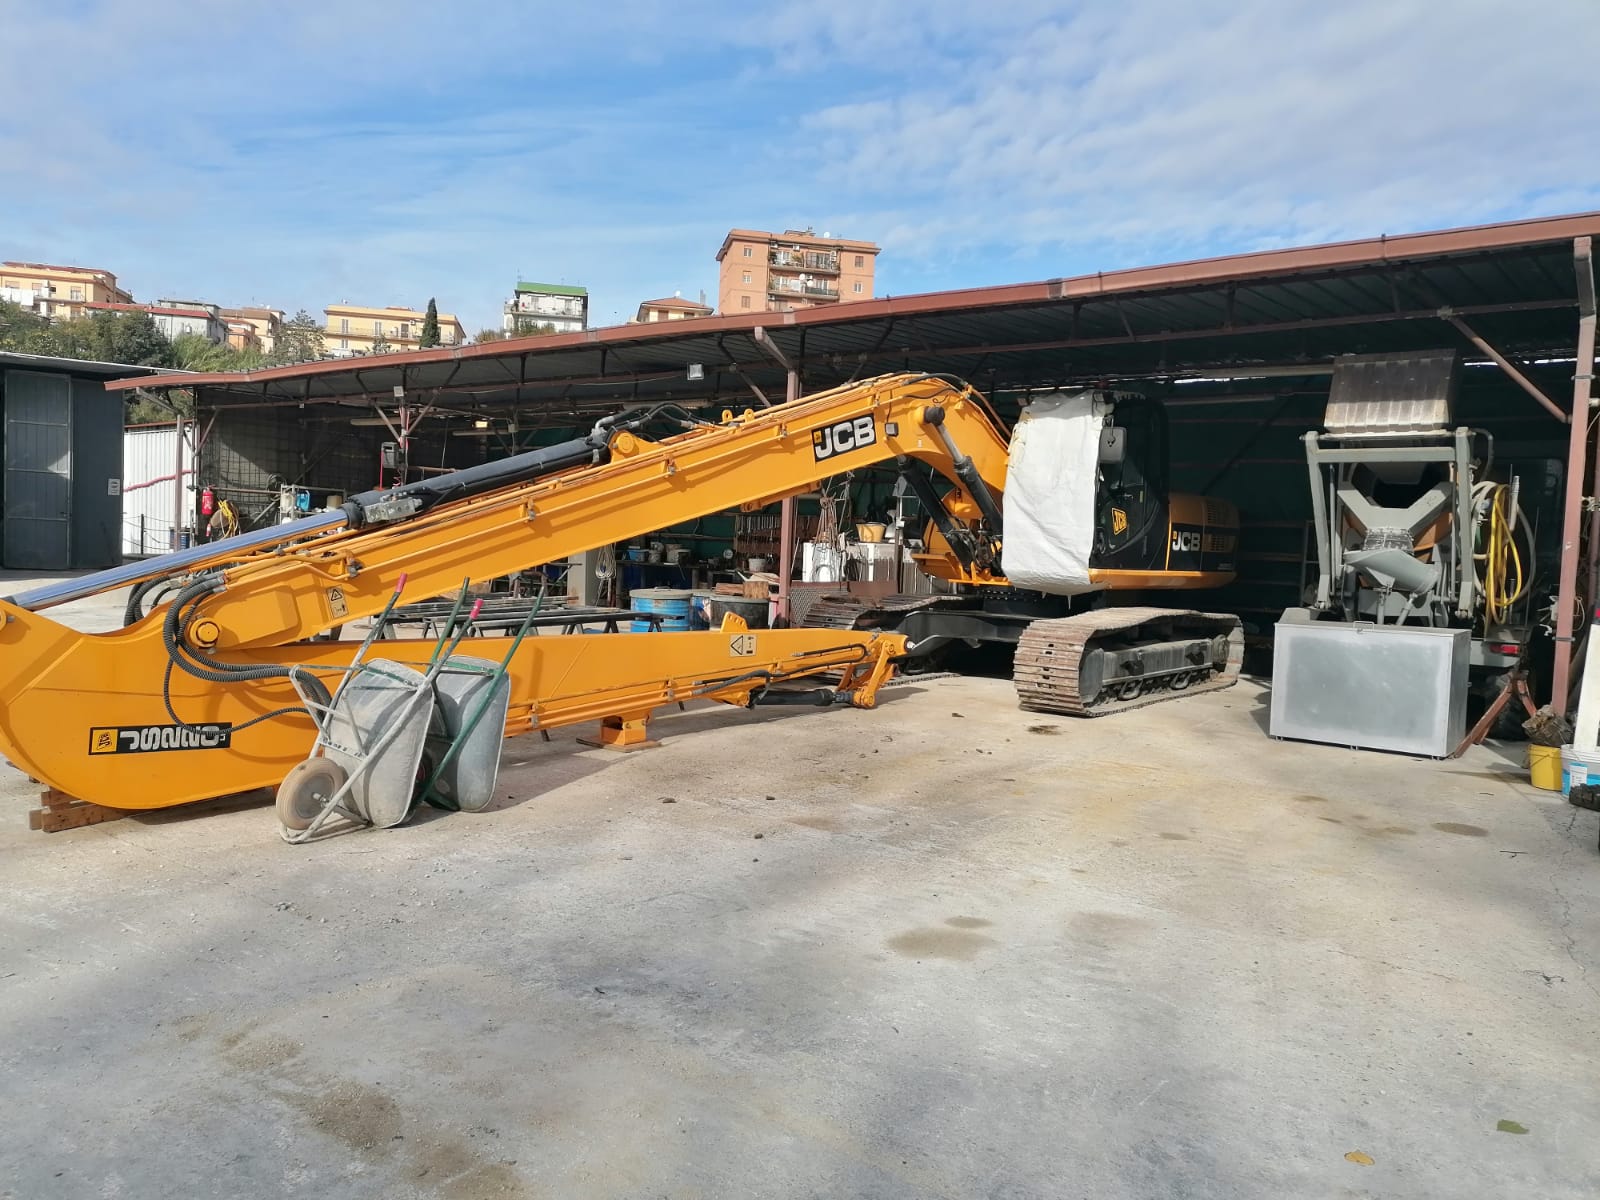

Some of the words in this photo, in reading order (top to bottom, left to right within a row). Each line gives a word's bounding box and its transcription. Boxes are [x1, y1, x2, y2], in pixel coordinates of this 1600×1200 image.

[815, 416, 875, 459] JCB
[1114, 510, 1127, 532] JCB
[1172, 531, 1200, 552] JCB
